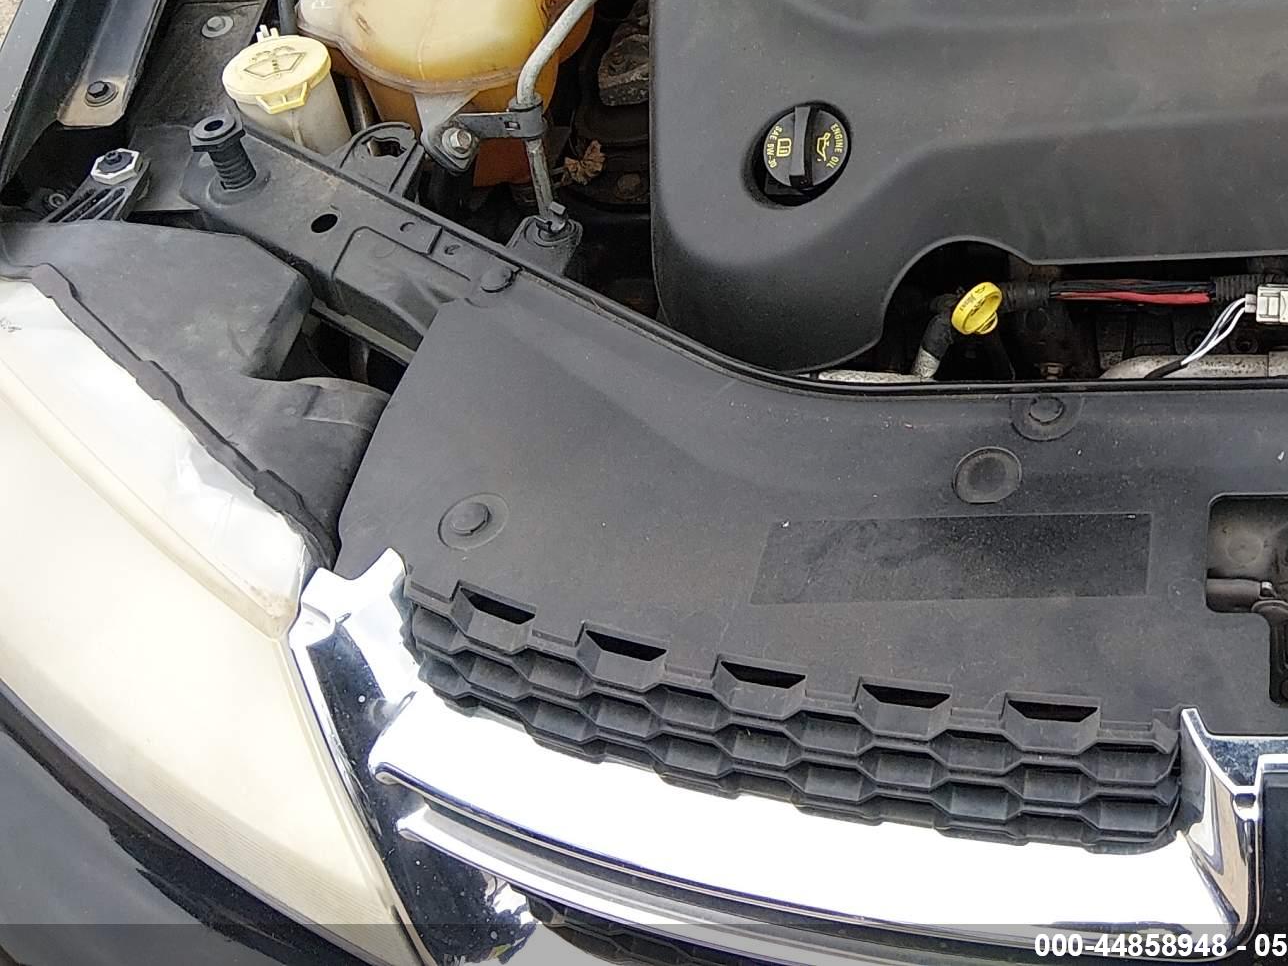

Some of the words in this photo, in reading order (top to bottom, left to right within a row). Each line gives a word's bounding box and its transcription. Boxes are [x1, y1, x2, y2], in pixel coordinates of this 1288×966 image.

[769, 125, 783, 141] SAE
[830, 123, 844, 154] ENGINE
[826, 156, 840, 169] OIL
